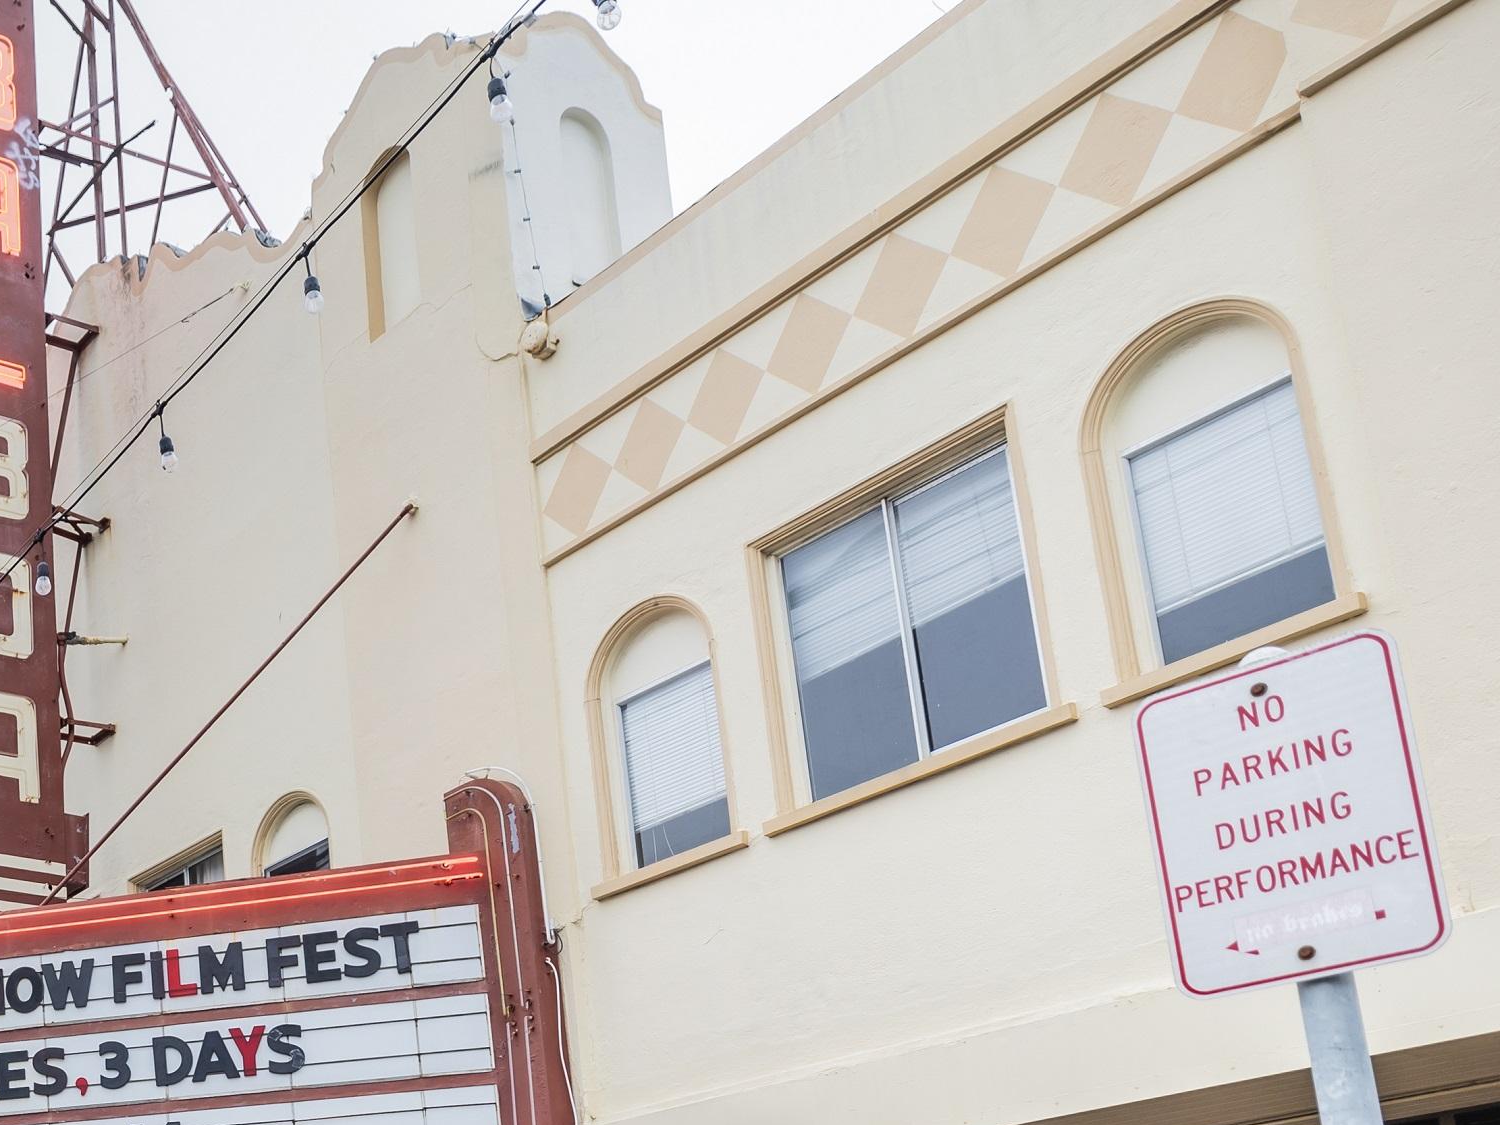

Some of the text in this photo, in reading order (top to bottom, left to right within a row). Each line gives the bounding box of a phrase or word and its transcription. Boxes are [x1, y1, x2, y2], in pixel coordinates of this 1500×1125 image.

[1237, 695, 1286, 732] NO
[1193, 728, 1354, 797] PARKING
[1214, 791, 1353, 851] DURING
[1174, 829, 1420, 913] PERFORMANCE
[112, 941, 247, 1004] FILM
[265, 920, 420, 988] FEST
[98, 1040, 132, 1091] 3
[152, 1023, 306, 1088] DAYS
